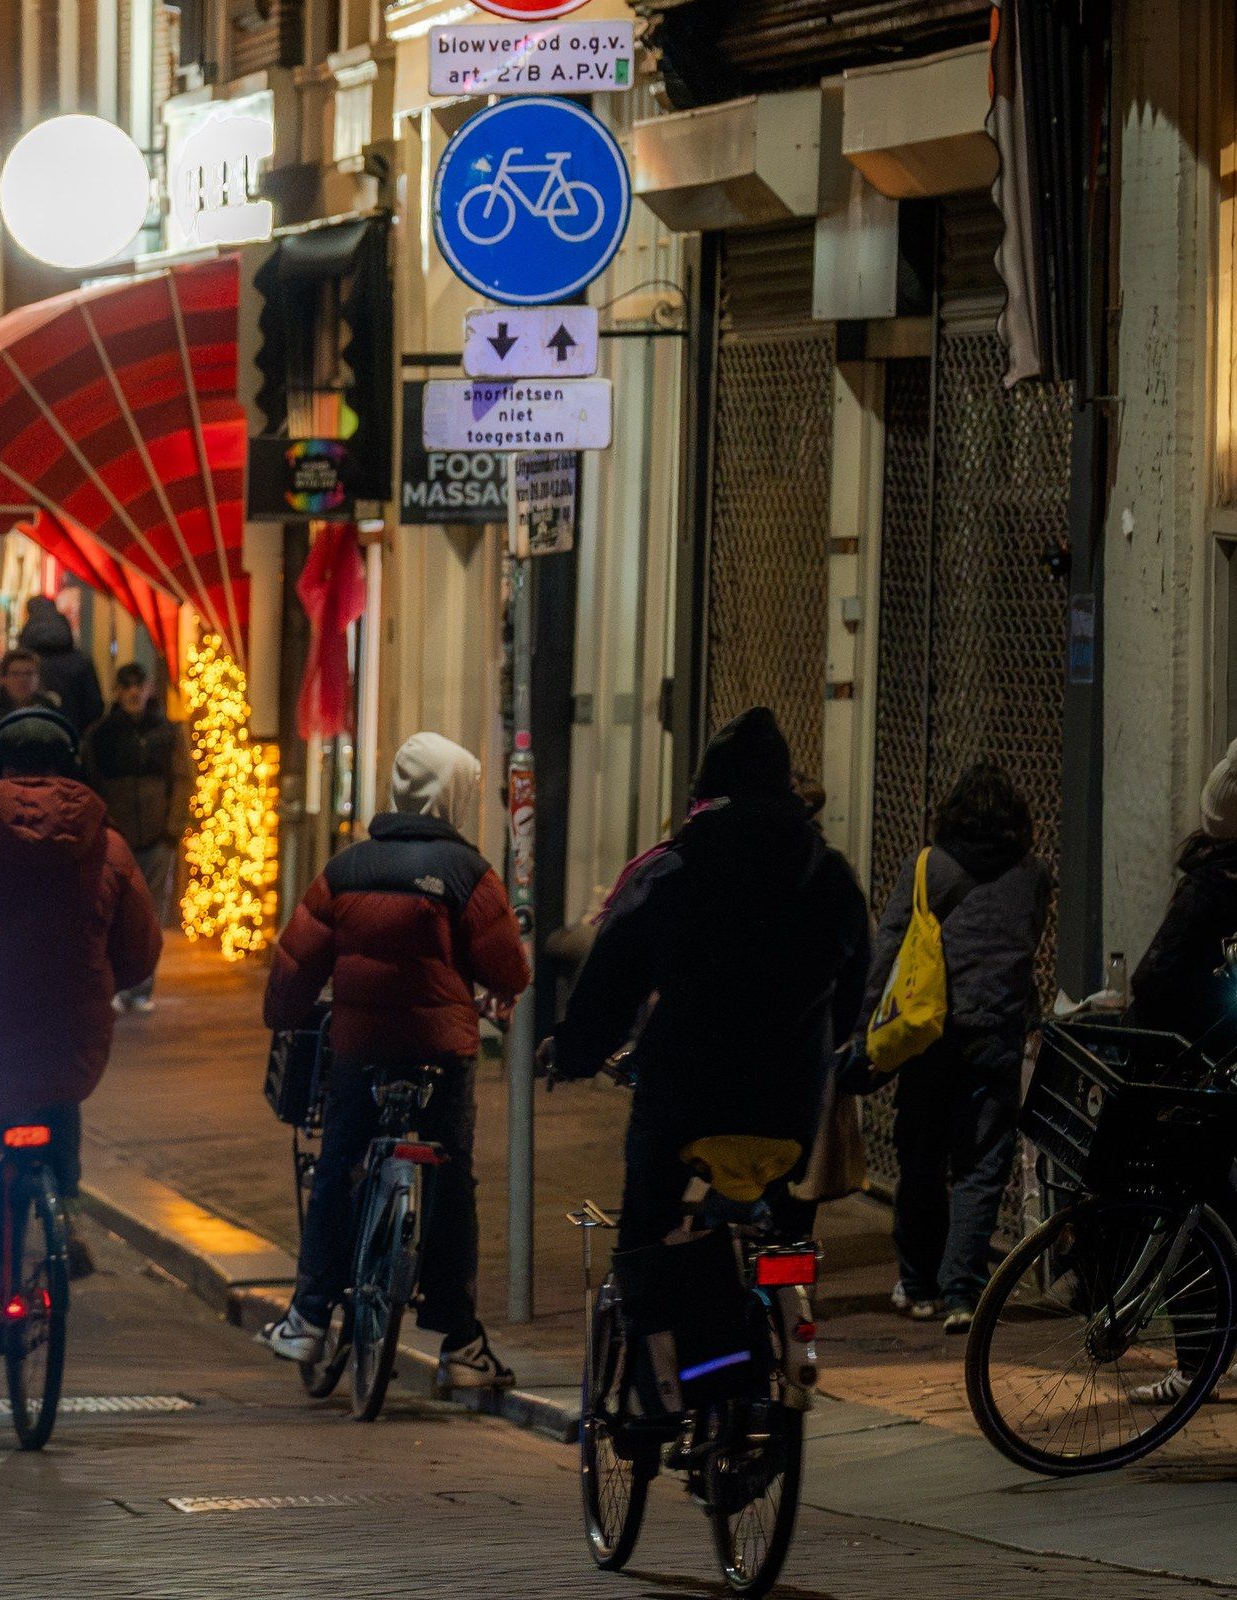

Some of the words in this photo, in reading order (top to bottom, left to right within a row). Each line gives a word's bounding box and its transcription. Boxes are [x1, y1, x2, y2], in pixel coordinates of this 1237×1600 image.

[464, 387, 564, 401] snorfietsen
[499, 408, 533, 422] niet
[467, 430, 564, 446] toegestaan
